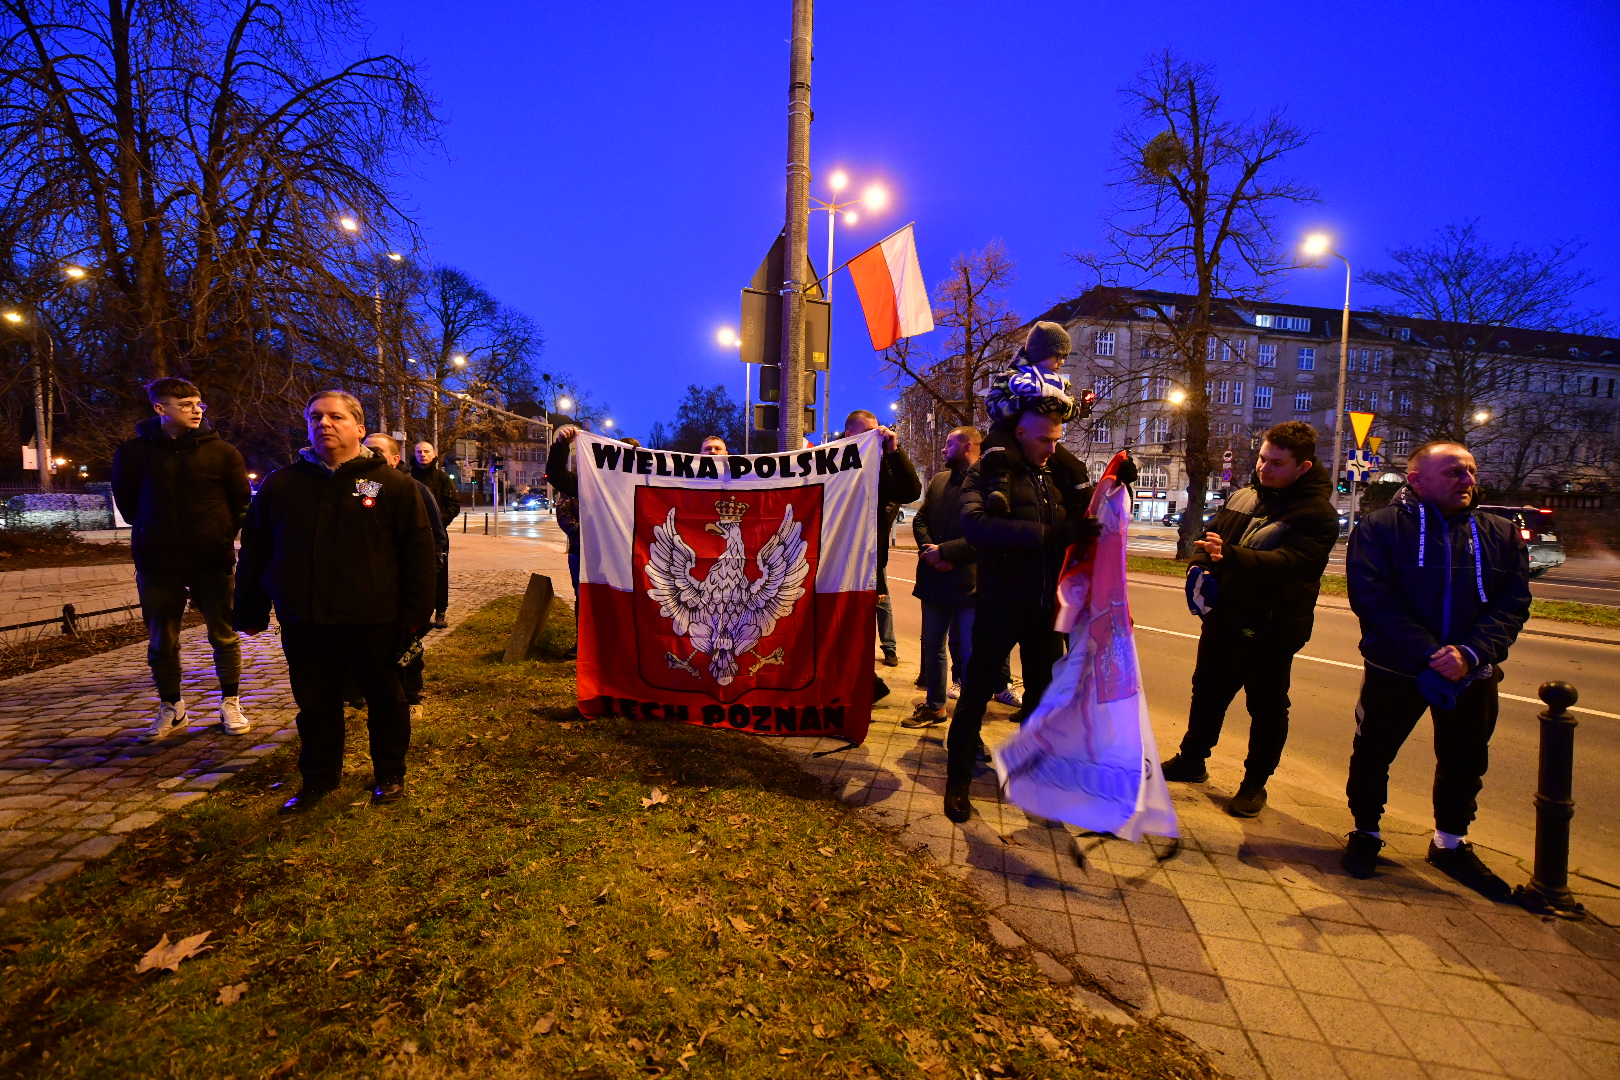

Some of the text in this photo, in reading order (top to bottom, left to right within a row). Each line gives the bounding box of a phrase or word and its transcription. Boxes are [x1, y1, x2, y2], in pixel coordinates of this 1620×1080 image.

[592, 442, 862, 479] WIELKA POLSKA
[601, 695, 844, 732] LECH POZNAŃ
